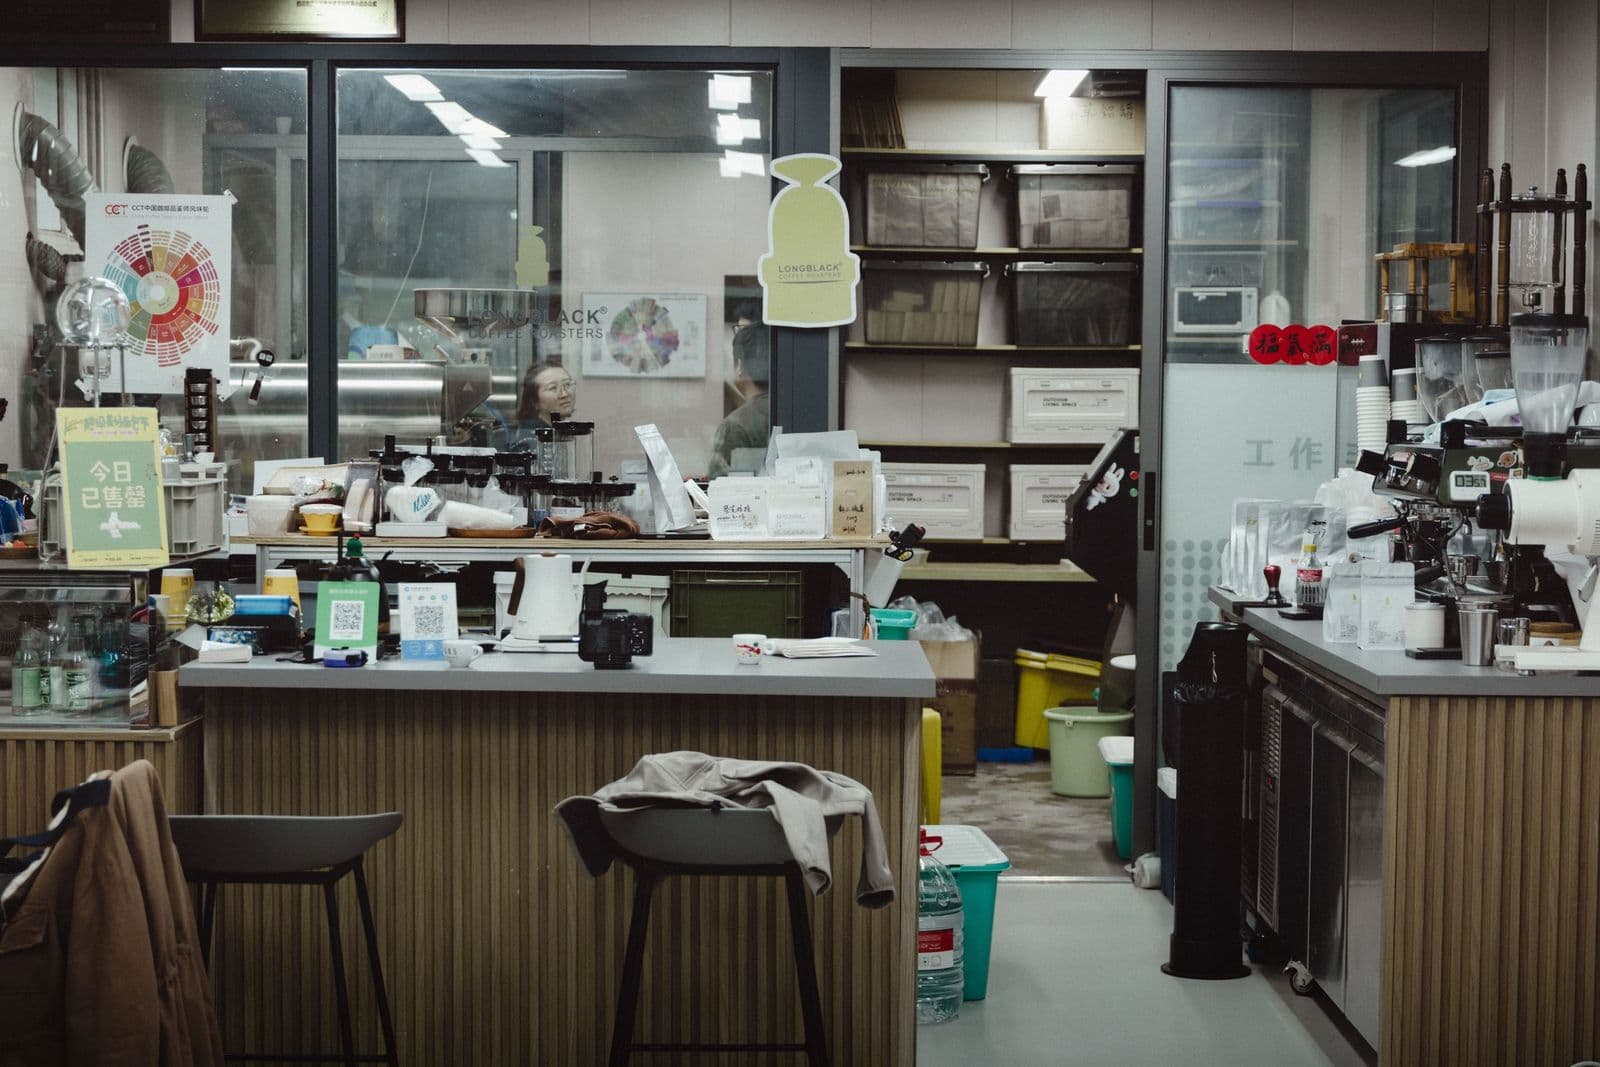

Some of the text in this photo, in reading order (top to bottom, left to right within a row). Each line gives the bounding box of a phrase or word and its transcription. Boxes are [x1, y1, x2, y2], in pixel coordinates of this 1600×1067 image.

[105, 204, 128, 215] CCT
[778, 264, 840, 273] LONGBLACK
[89, 461, 131, 483] 今日
[81, 485, 146, 509] 已售罄
